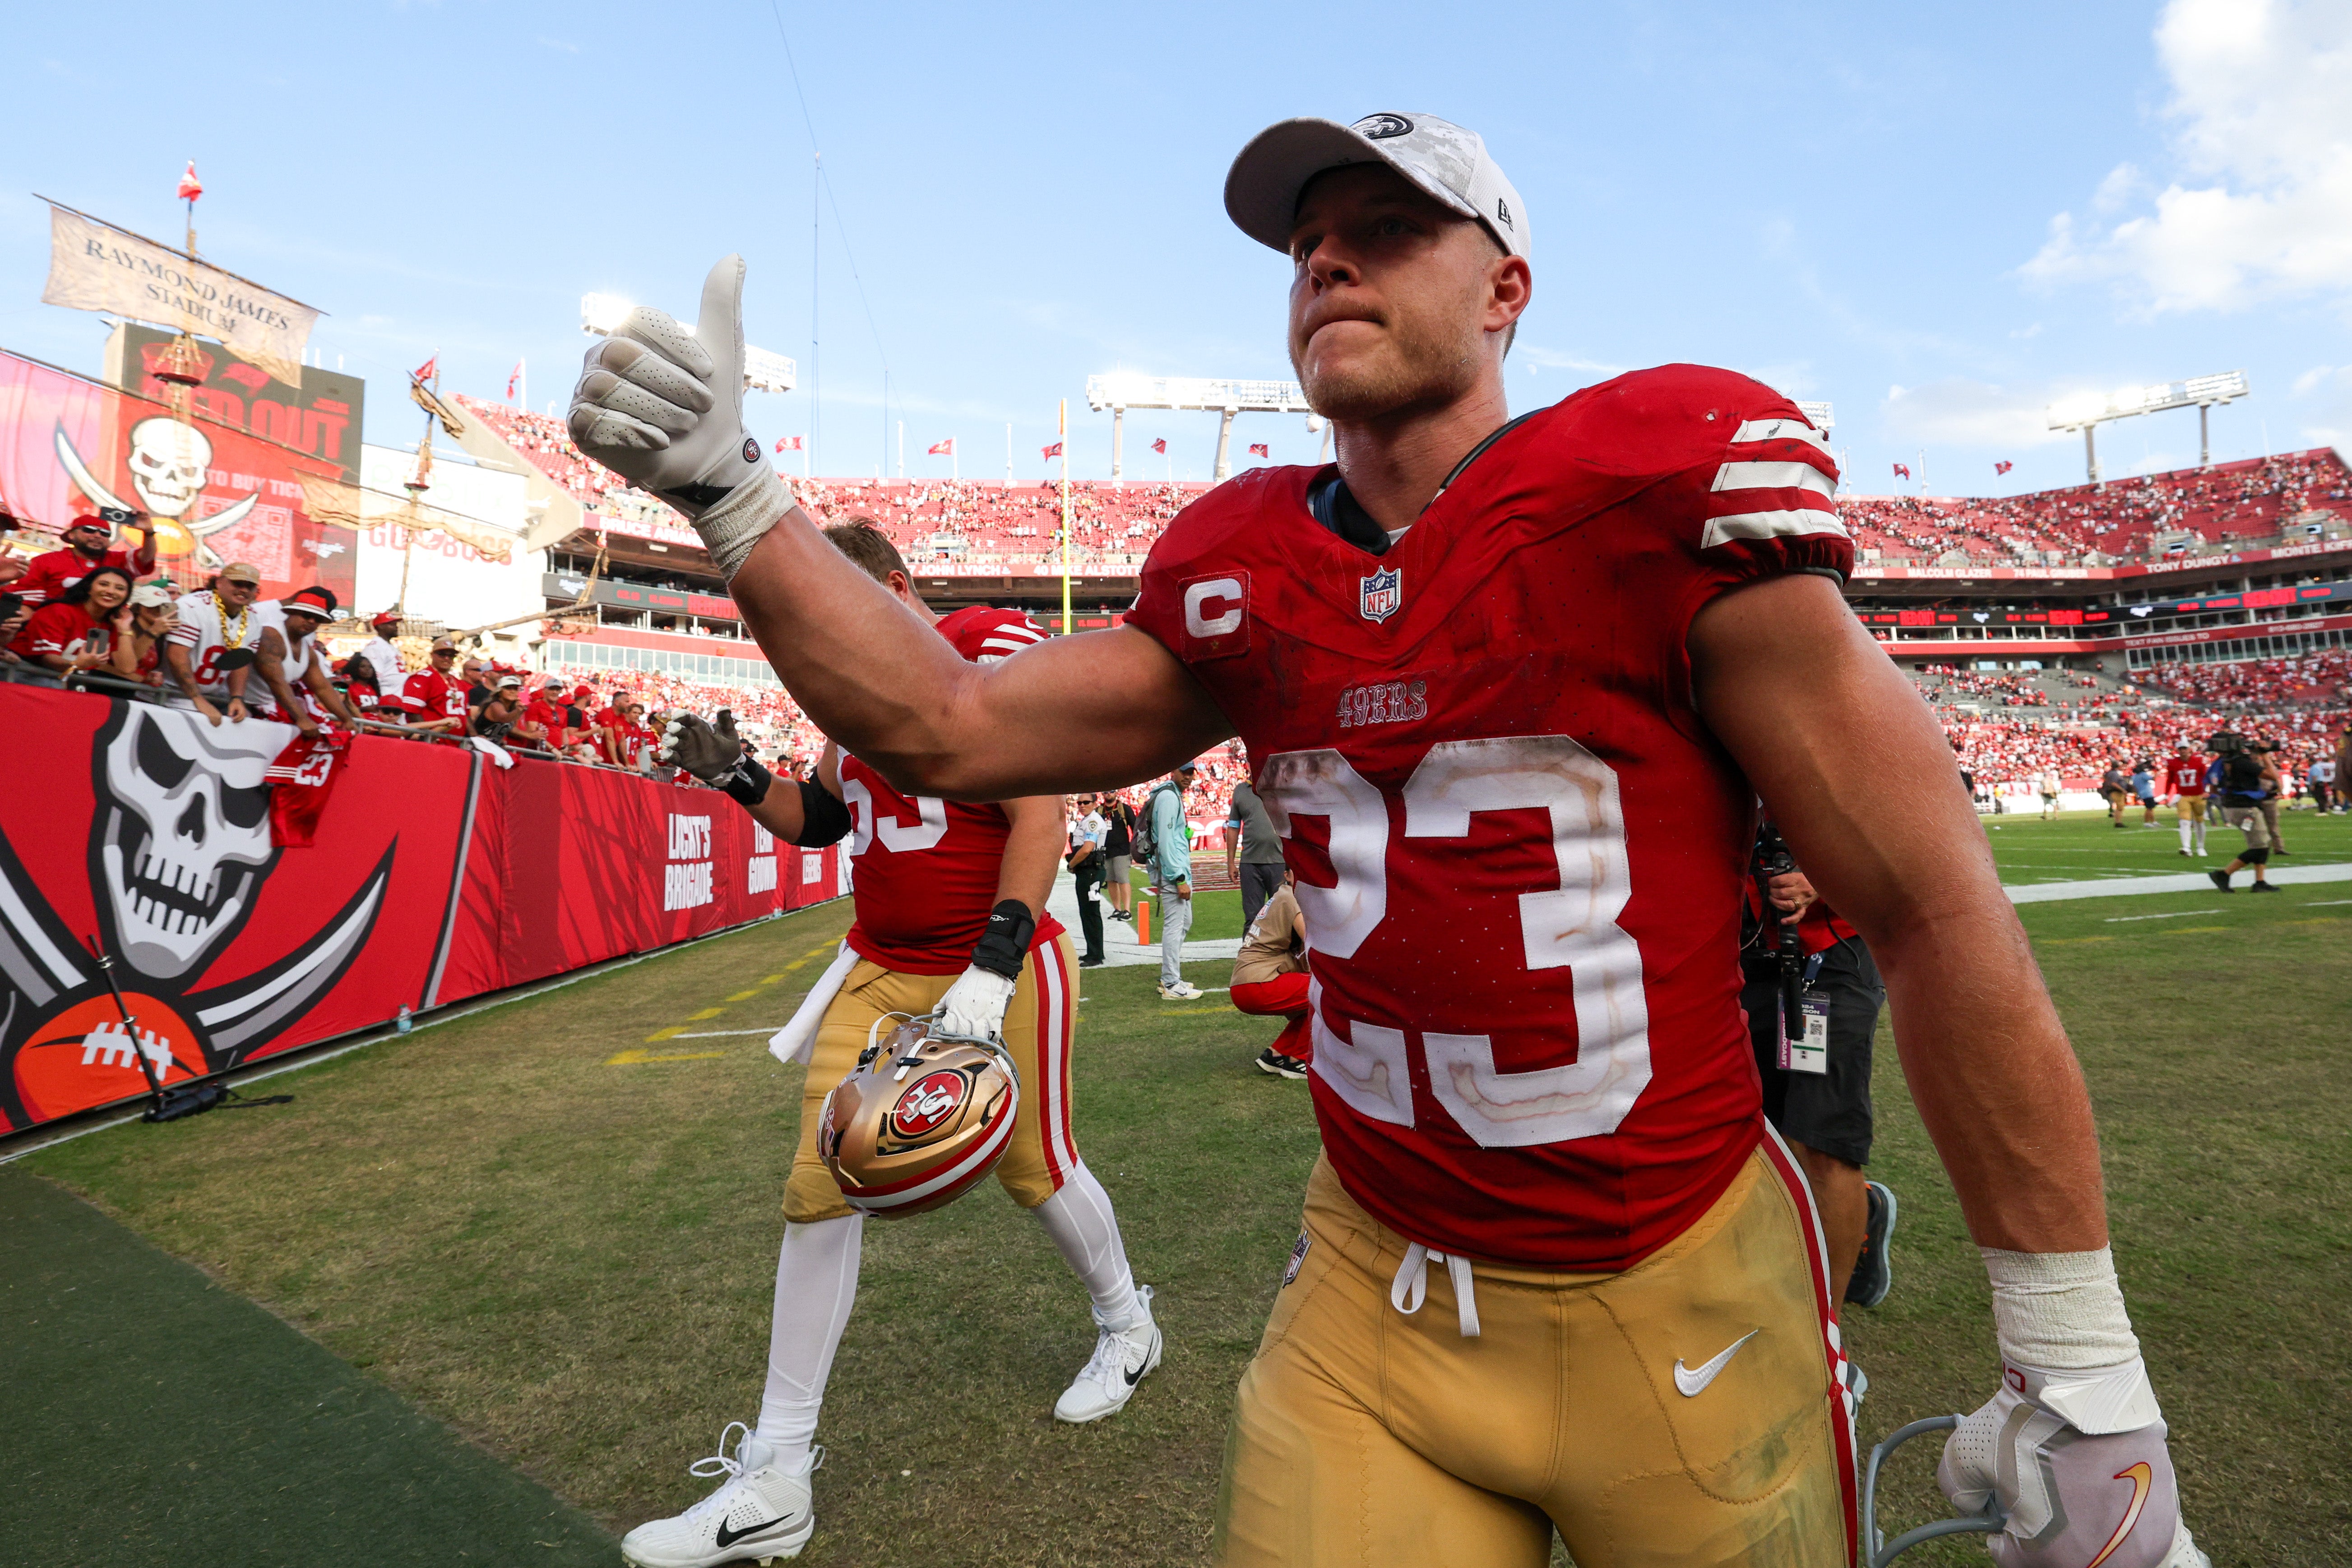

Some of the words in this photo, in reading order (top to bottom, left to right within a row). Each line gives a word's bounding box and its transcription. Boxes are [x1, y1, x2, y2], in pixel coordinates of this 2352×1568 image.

[86, 237, 217, 301] RAYMOND
[220, 294, 290, 330] JAMES
[147, 284, 236, 333] STADIUM
[251, 398, 350, 459] OUT
[231, 473, 266, 491] BUY
[599, 516, 651, 538] BRUCE
[2270, 543, 2323, 559] MONTE
[918, 564, 952, 576] JOHN
[958, 564, 1000, 576] LYNCH
[1033, 565, 1049, 576] 40
[1051, 565, 1083, 576] MKE
[1085, 565, 1141, 576] ALSTOTT
[1852, 568, 1884, 578] LLIAMS
[1907, 568, 1954, 578] MALCOLM
[1955, 568, 1992, 578] GLAZER
[2145, 560, 2180, 574] TONY
[2182, 555, 2230, 569] DUNGY
[1184, 578, 1242, 638] C
[1366, 591, 1394, 613] NFL
[1335, 680, 1427, 728] 49ERS
[294, 753, 333, 787] 23
[2177, 768, 2197, 787] 17
[664, 861, 713, 911] BRIGADE
[1249, 924, 1261, 937] DIA
[1257, 735, 1653, 1148] 23
